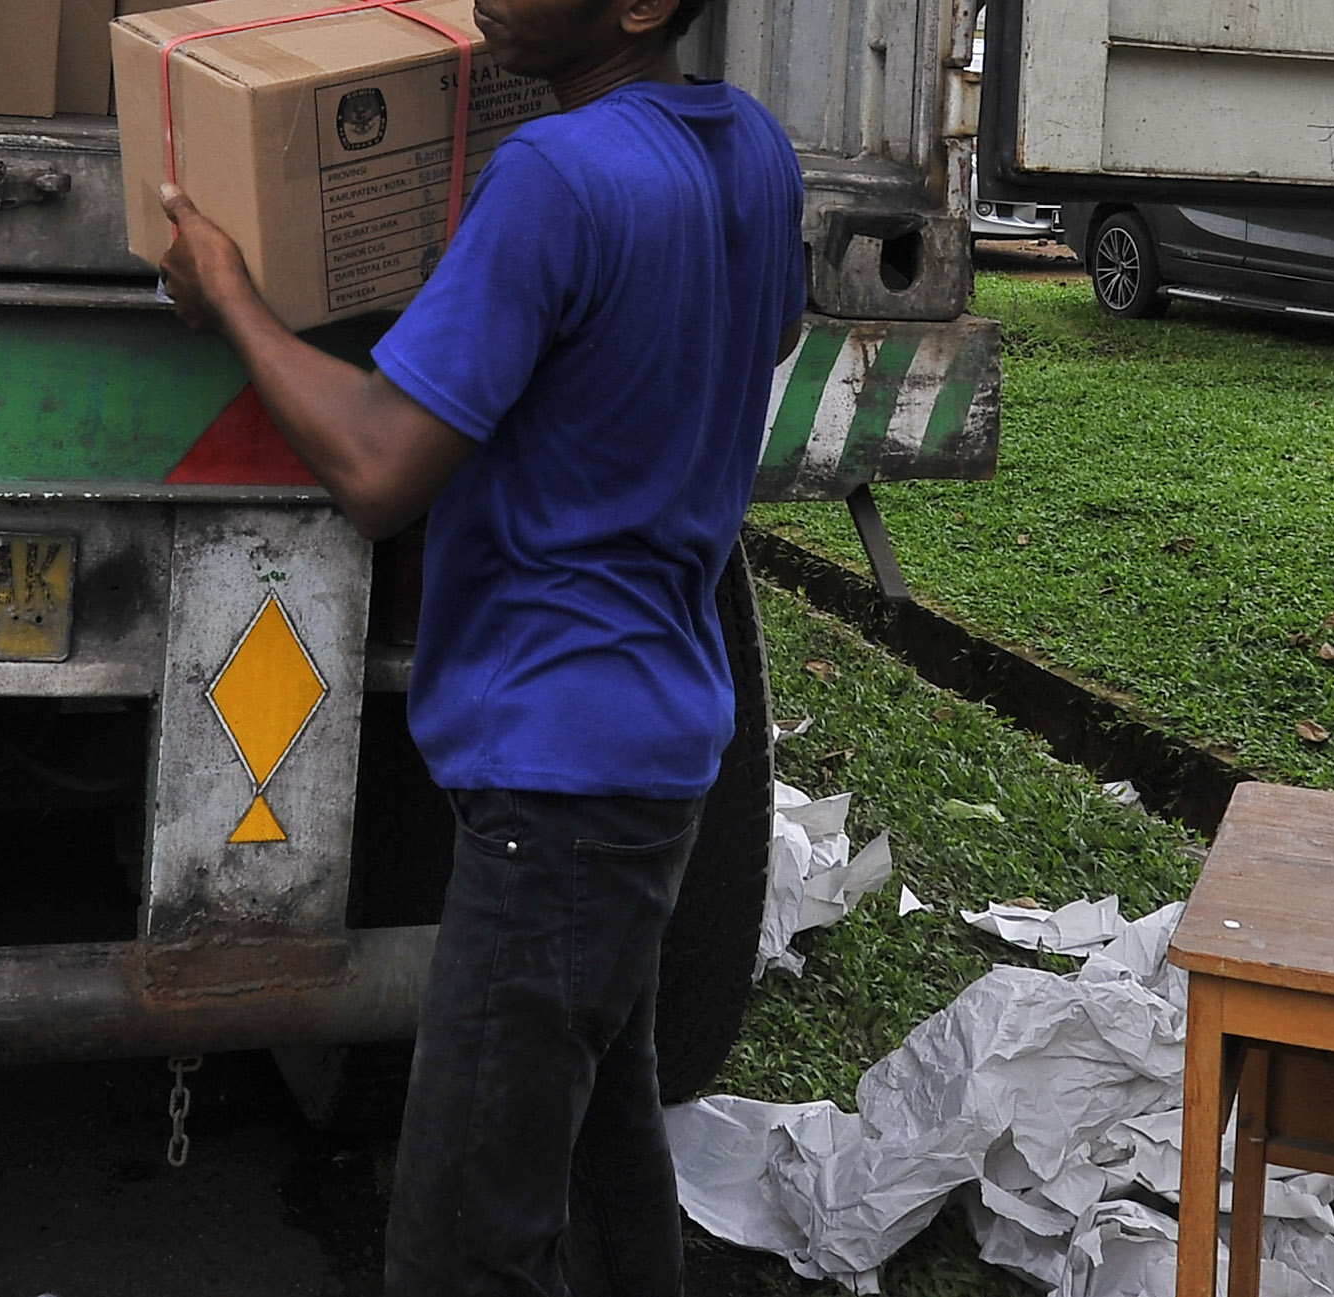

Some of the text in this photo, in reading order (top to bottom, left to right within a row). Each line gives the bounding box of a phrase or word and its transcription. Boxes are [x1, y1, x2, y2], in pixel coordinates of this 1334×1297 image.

[478, 99, 542, 124] TAHUN 2019
[327, 166, 368, 182] PROVINSI
[328, 185, 378, 204] KABUPATEN
[368, 241, 386, 254] DUS
[382, 257, 401, 269] DUS
